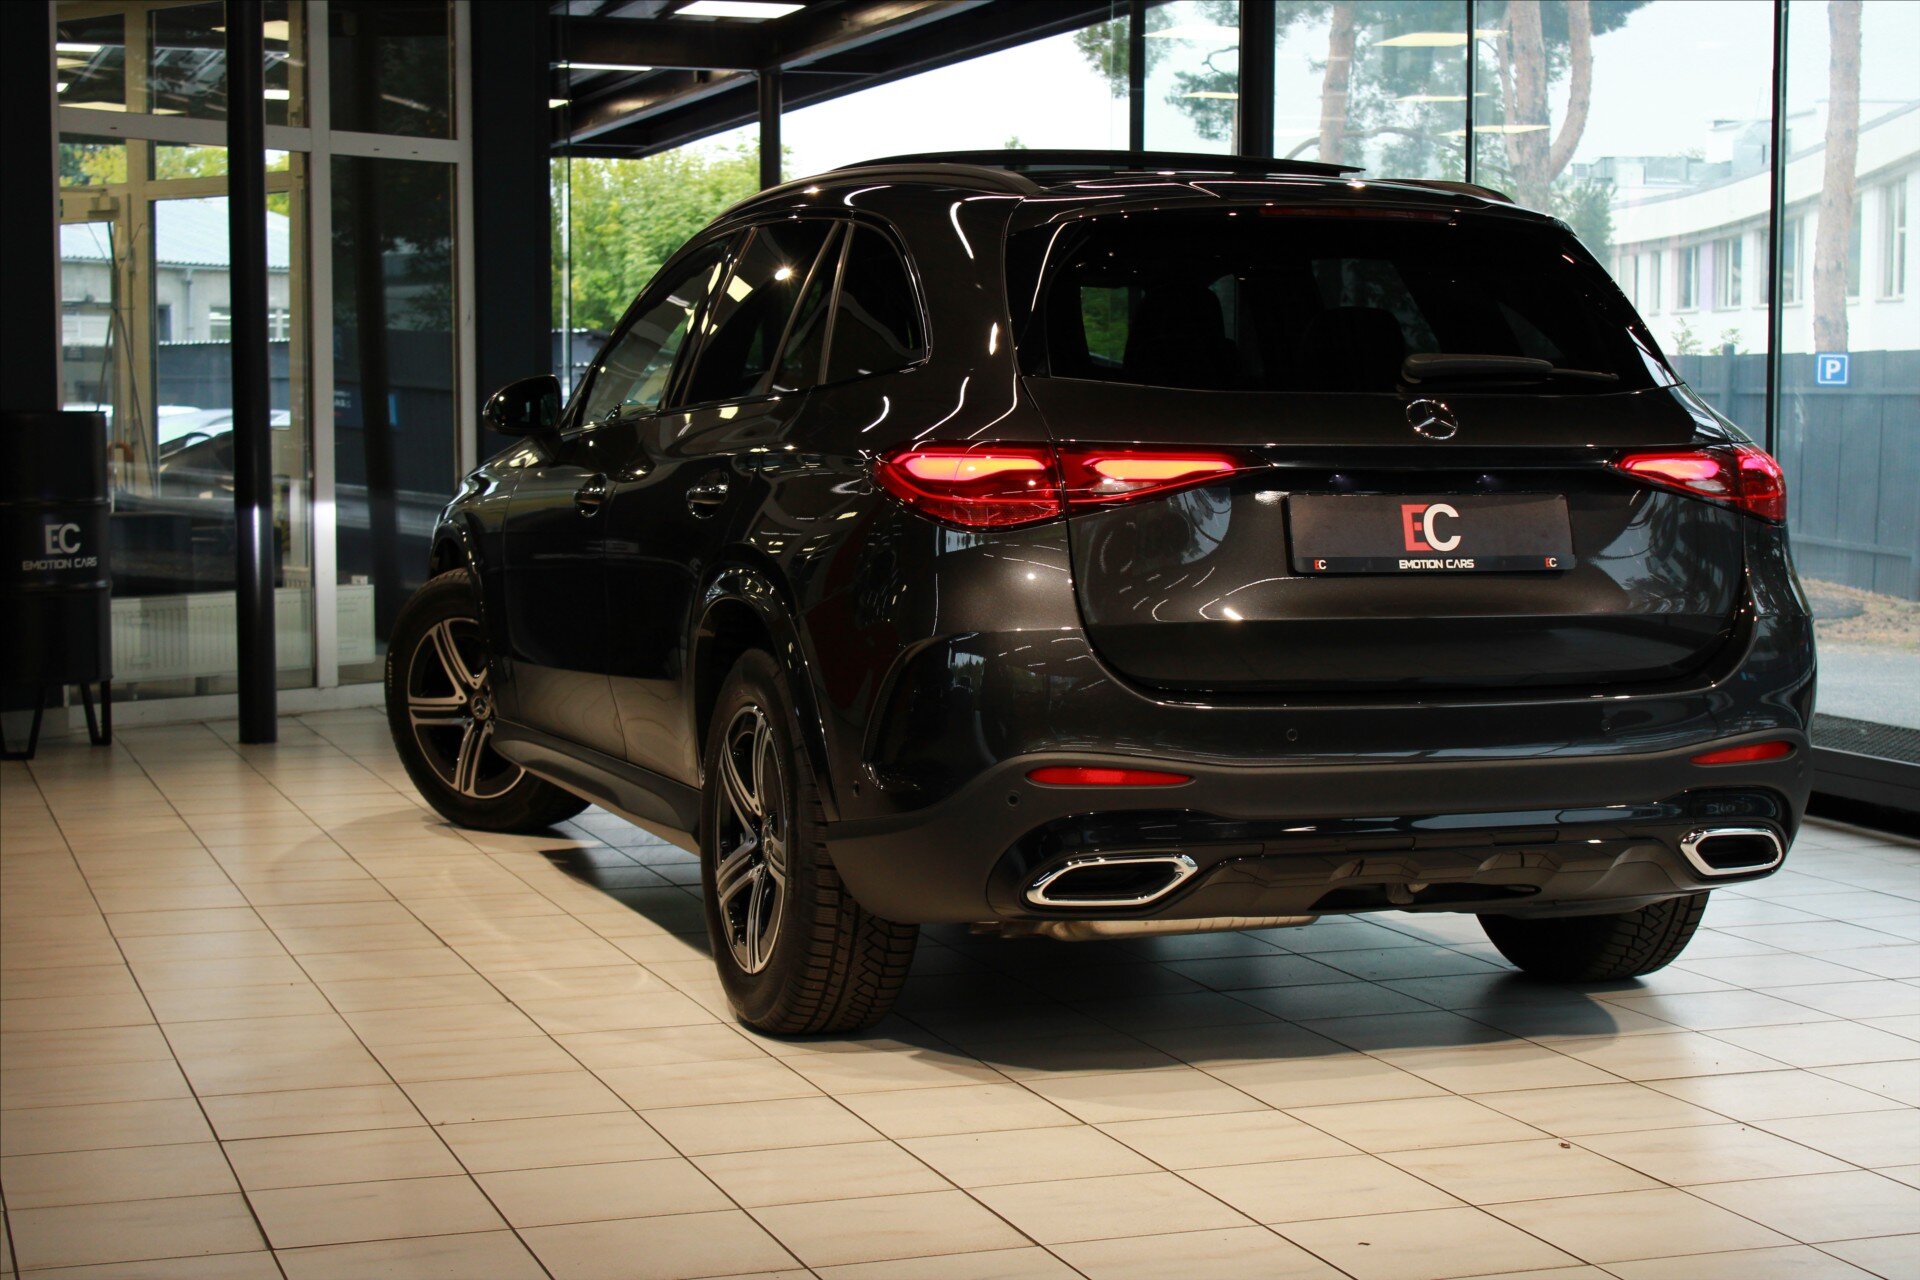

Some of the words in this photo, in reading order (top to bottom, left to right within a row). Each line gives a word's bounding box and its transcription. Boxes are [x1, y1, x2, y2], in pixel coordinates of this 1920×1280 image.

[1826, 359, 1841, 380] P
[1401, 503, 1462, 552] EC
[45, 523, 81, 554] EC
[22, 559, 72, 571] EMOTION
[74, 557, 97, 569] CARS
[1398, 559, 1444, 569] EMOTION
[1445, 559, 1475, 569] CARS
